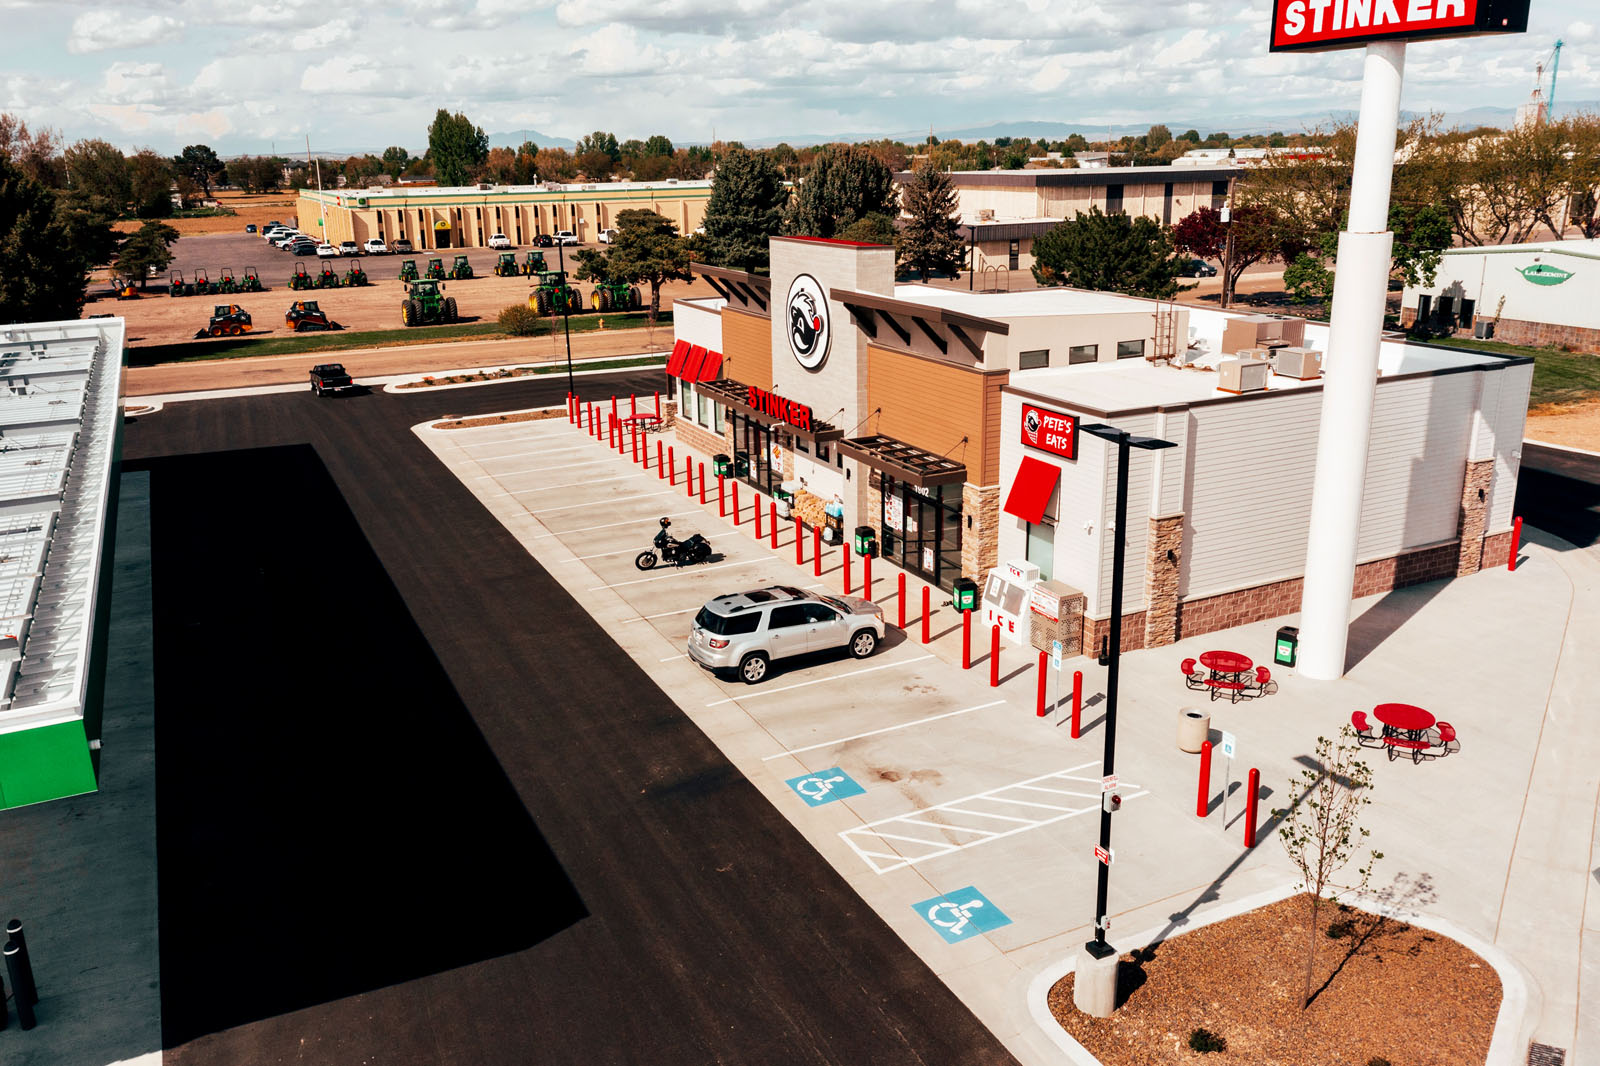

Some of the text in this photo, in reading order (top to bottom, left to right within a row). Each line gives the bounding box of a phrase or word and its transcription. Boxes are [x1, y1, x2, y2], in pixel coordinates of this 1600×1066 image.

[1283, 0, 1466, 36] STINKER
[748, 385, 811, 432] STINKER
[1043, 415, 1072, 434] PETE'S
[1045, 433, 1068, 450] EATS
[1009, 567, 1021, 577] ICE
[989, 610, 1015, 633] ICE
